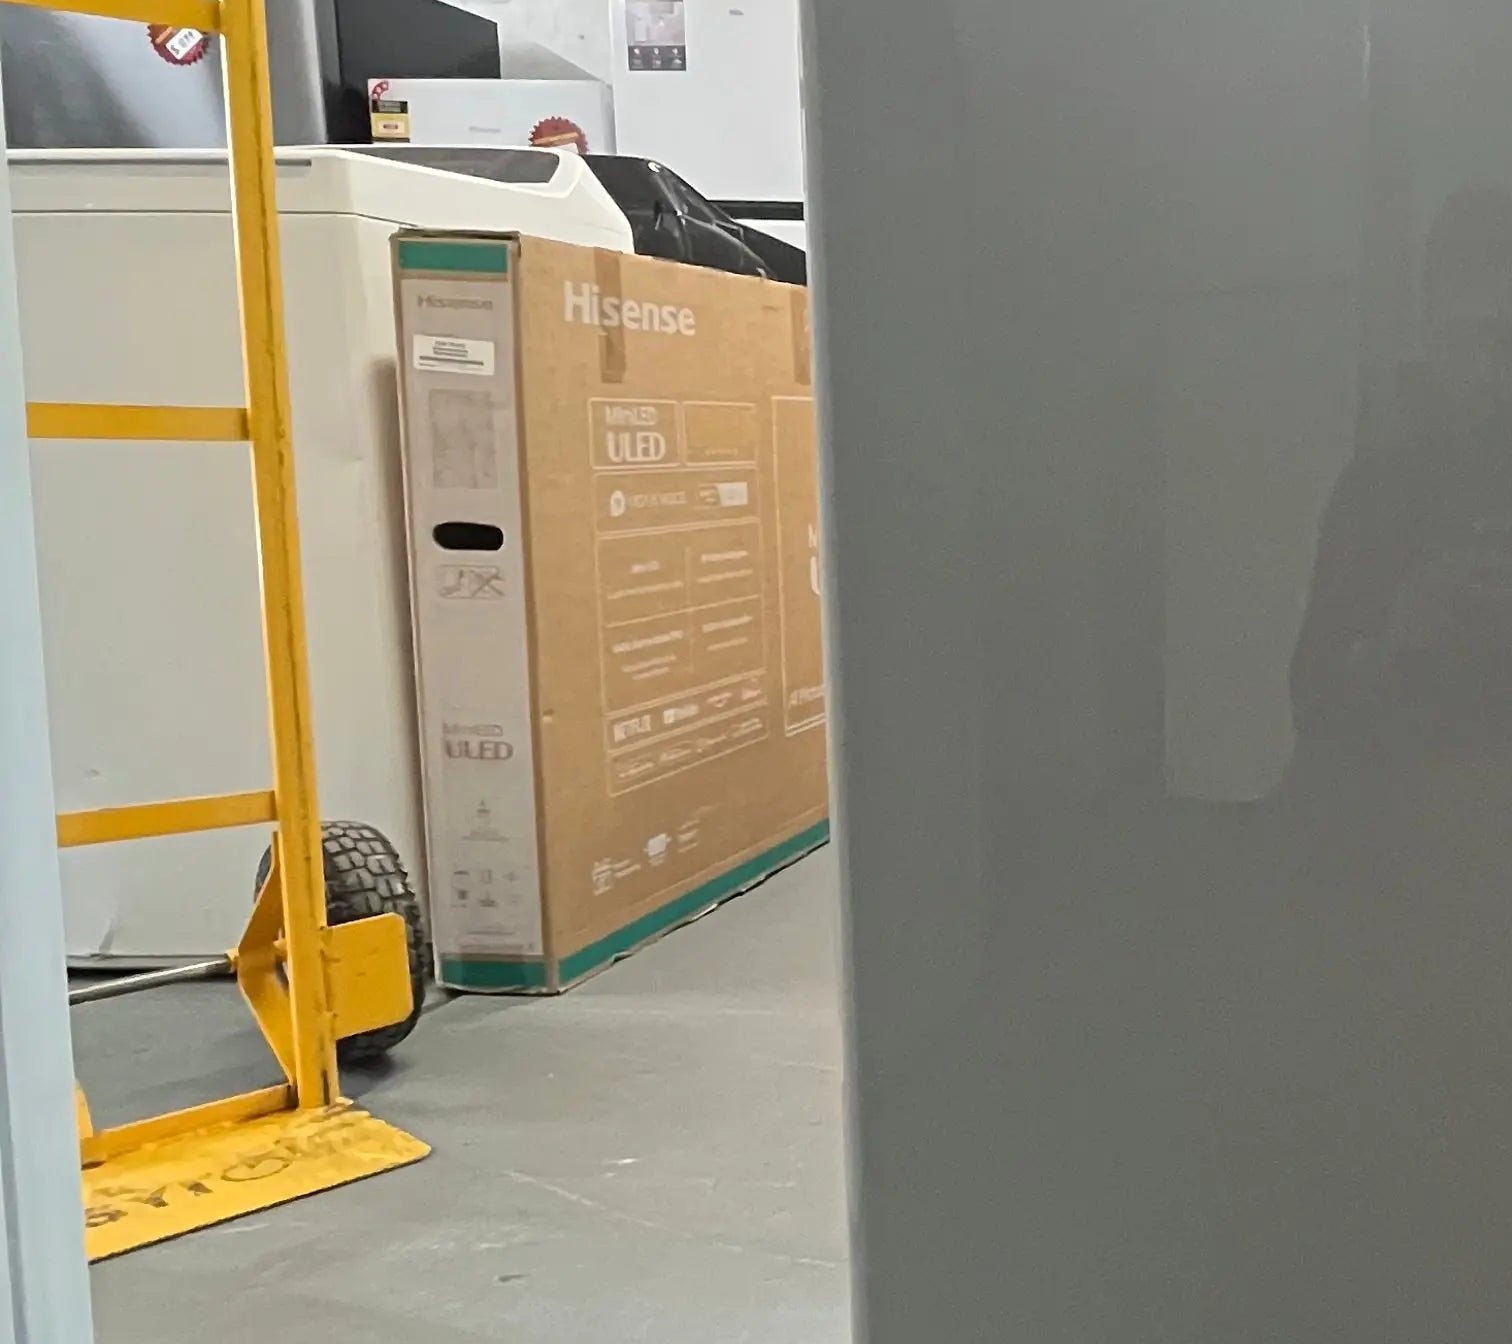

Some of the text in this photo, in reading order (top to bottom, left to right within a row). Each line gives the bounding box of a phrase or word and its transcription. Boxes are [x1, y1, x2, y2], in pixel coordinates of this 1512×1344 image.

[564, 280, 696, 336] Hisense
[606, 431, 667, 464] ULED
[444, 739, 514, 761] ULED
